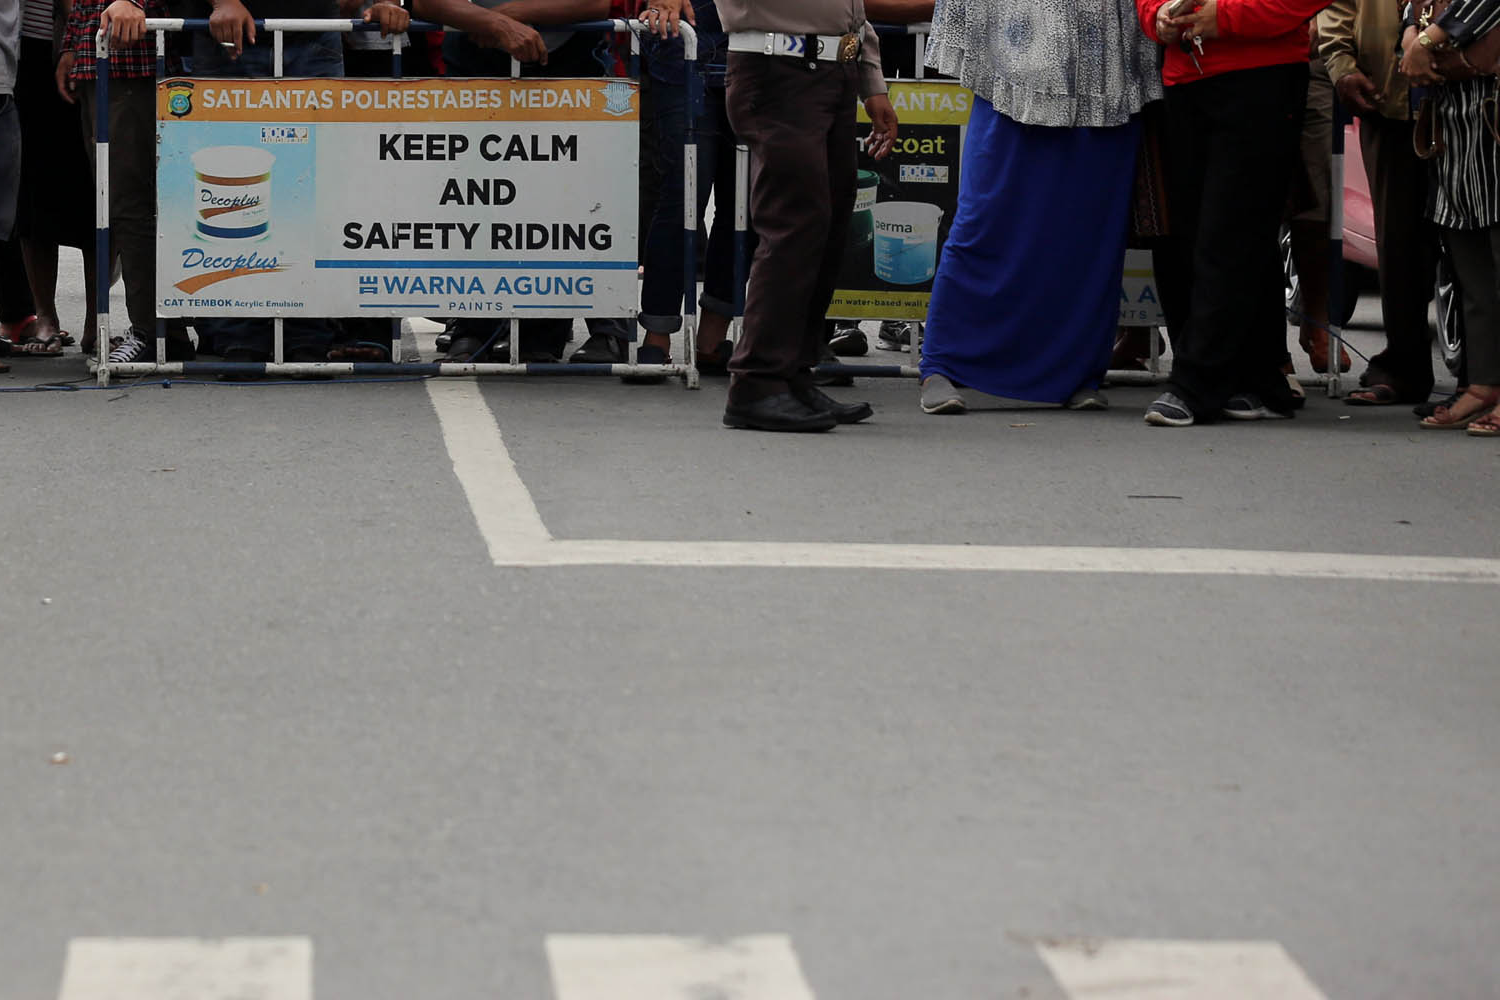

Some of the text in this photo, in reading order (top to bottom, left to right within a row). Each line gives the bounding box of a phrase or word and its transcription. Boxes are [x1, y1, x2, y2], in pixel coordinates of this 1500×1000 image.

[202, 88, 592, 110] SATLANTAS POLRESTABES MEDAN
[892, 91, 969, 113] ANTAS
[378, 133, 578, 162] KEEP CALM
[201, 188, 260, 209] Decoplus
[439, 177, 517, 206] AND
[342, 221, 613, 251] SAFETY RIDING
[182, 248, 279, 272] Decoplus
[383, 275, 595, 296] WARNA AGUNG
[163, 298, 304, 309] CAT TEMBOK Acrylic Emulsion
[448, 301, 503, 311] PAINTS
[845, 298, 902, 307] water-based
[904, 299, 923, 307] wall
